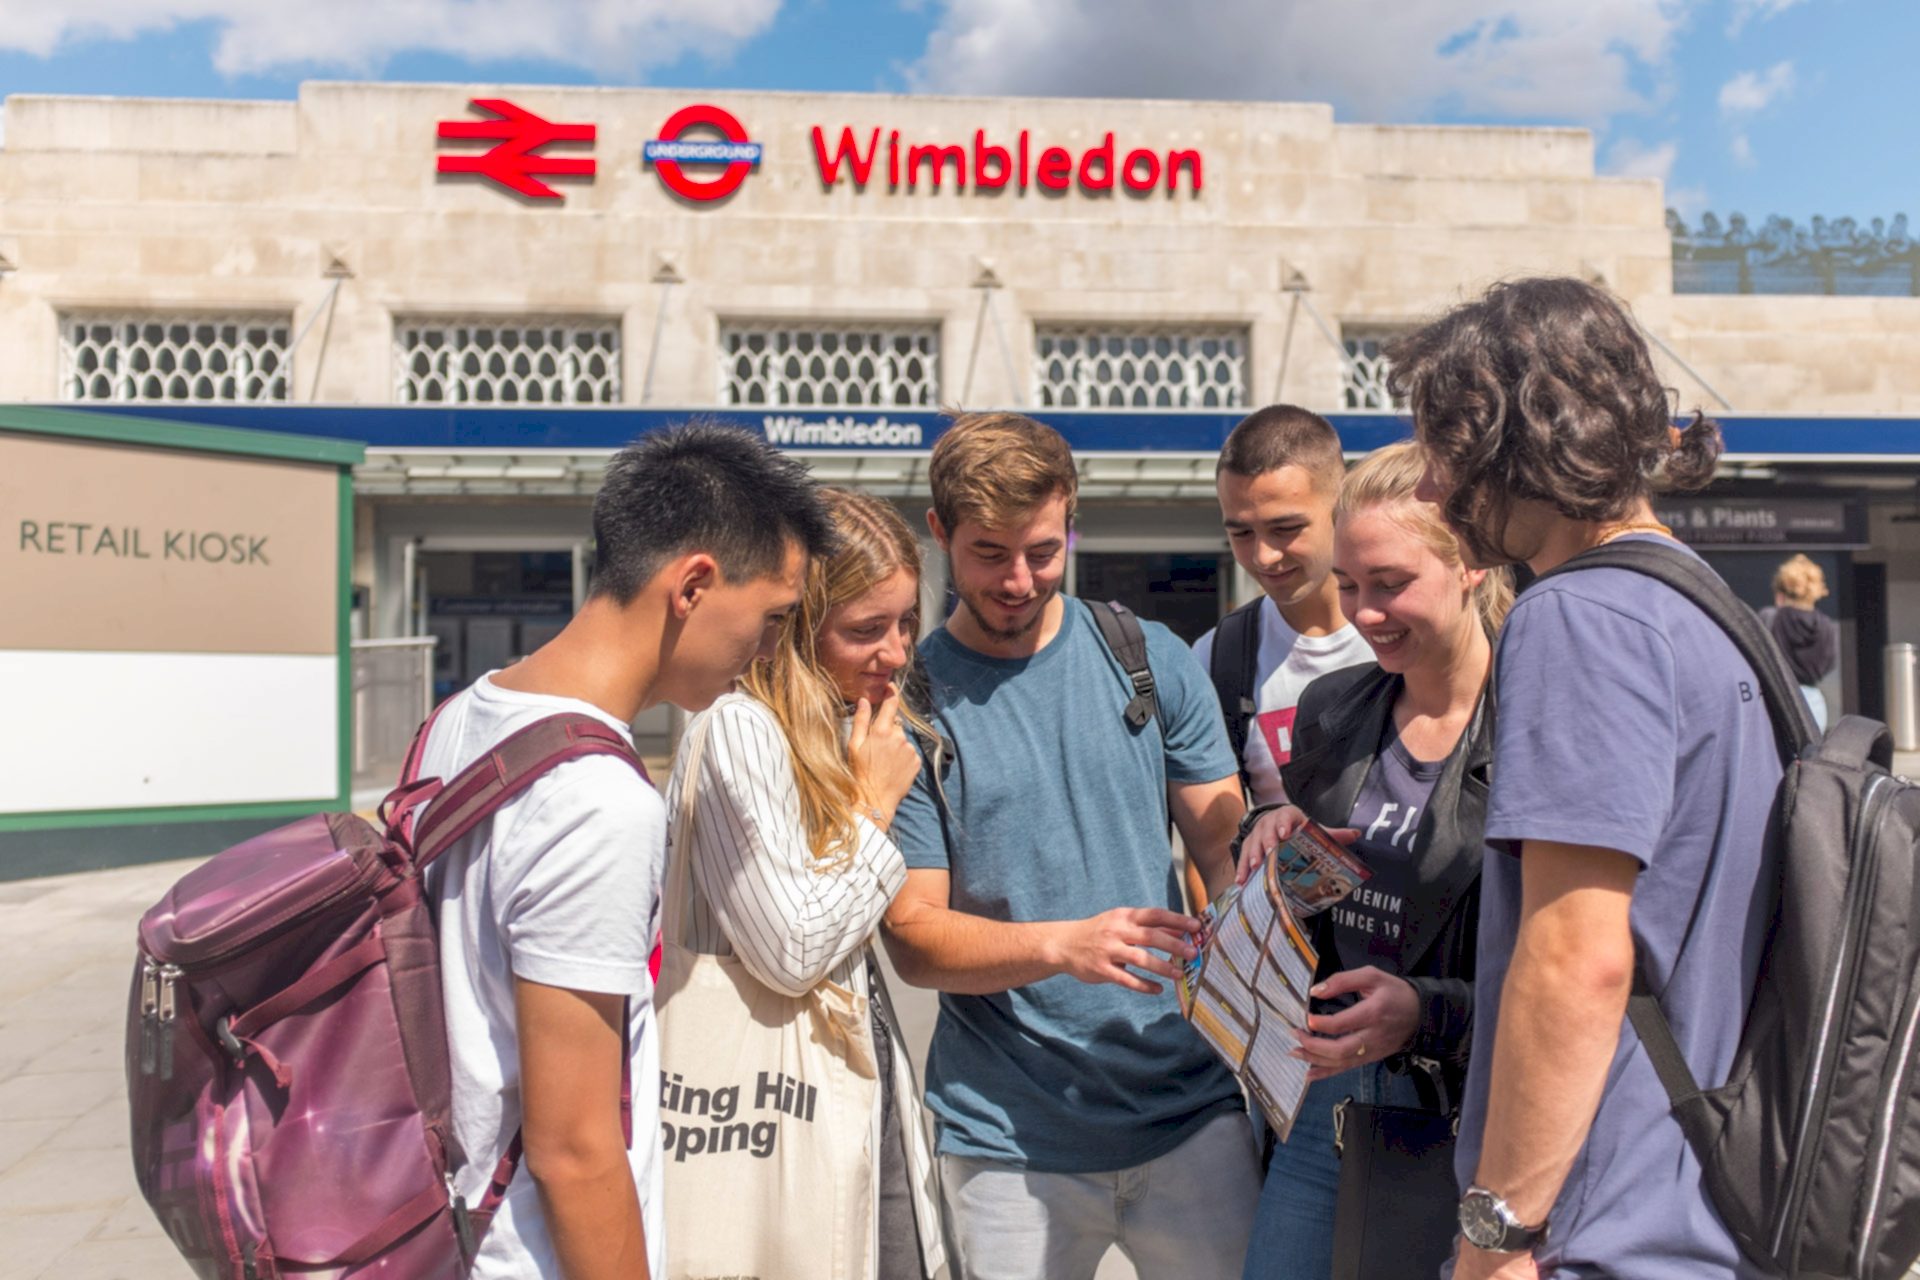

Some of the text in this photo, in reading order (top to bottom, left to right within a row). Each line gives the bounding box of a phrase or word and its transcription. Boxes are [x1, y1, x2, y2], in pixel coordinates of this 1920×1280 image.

[646, 143, 760, 160] UNDERGROUND
[812, 125, 1202, 191] Wimbledon
[763, 415, 922, 446] Wimbledon
[1691, 507, 1707, 528] &
[1711, 506, 1777, 528] Plants
[20, 519, 270, 566] RETAIL KIOSK
[1352, 887, 1402, 914] DENIM
[1331, 906, 1401, 938] SINCE 19
[754, 1071, 818, 1122] Hill
